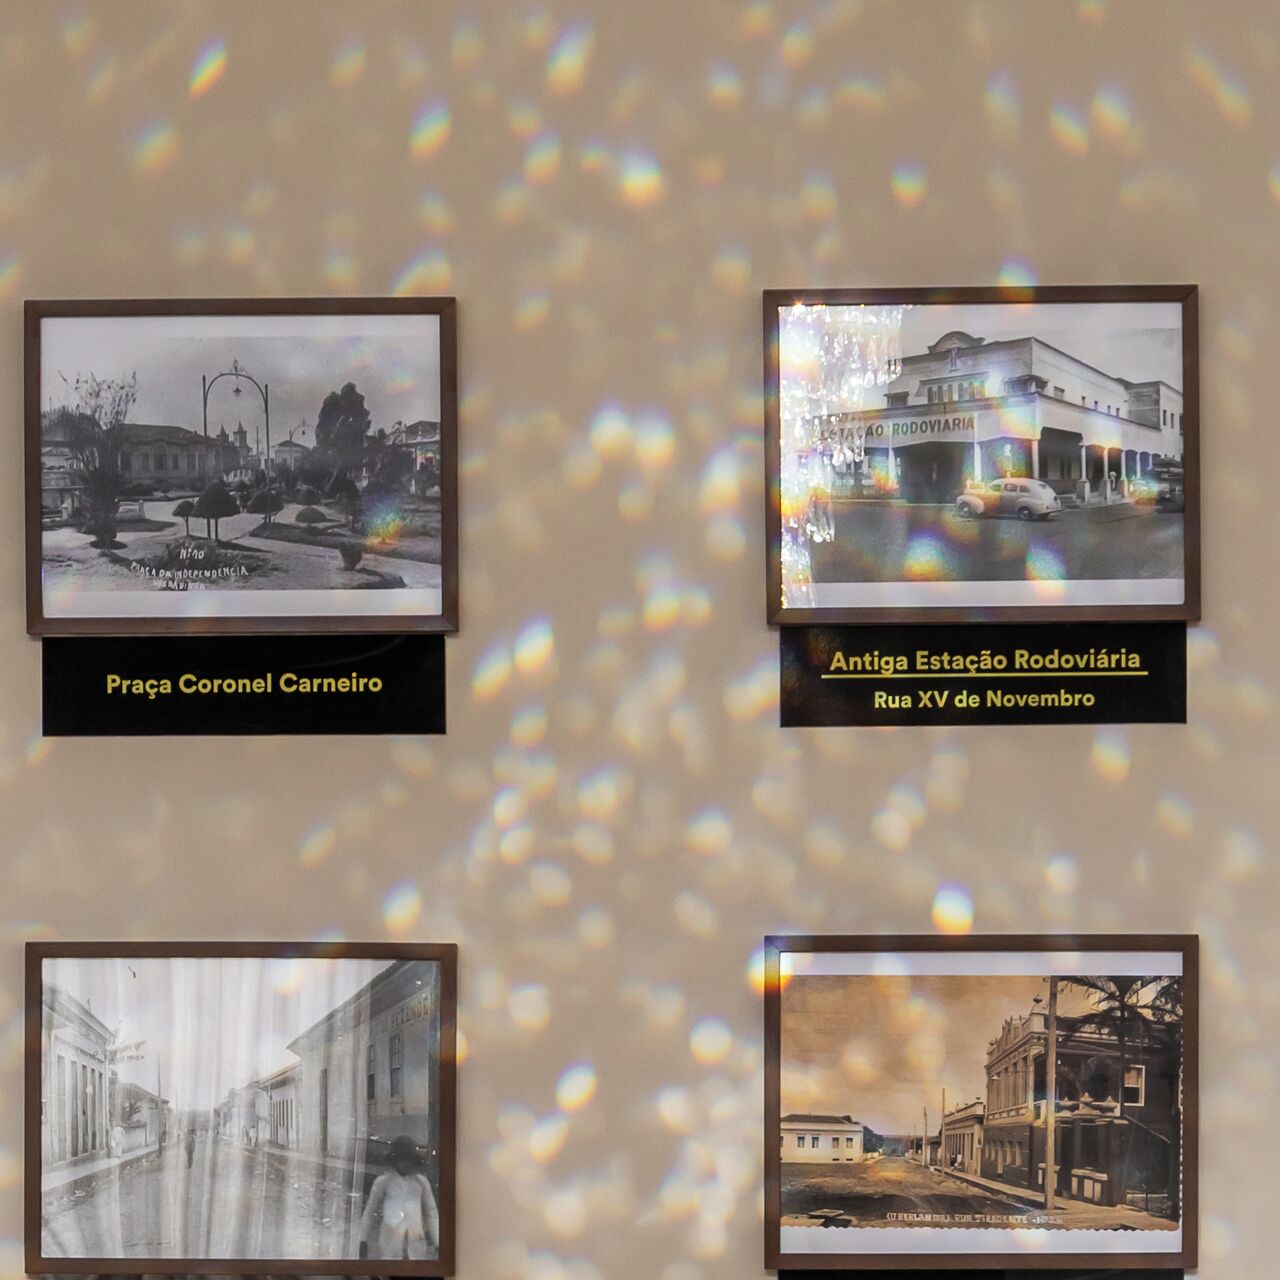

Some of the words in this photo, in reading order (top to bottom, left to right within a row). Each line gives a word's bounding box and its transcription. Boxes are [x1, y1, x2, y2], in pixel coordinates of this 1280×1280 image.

[830, 650, 908, 674] Antiga
[916, 650, 1008, 674] Estação
[1014, 648, 1140, 670] Rodoviária
[106, 674, 172, 700] Praça
[178, 672, 272, 694] Coronel
[279, 672, 383, 693] Carneiro
[874, 691, 912, 709] Rua
[918, 690, 949, 708] XV
[954, 690, 981, 708] de
[987, 689, 1096, 708] Novembro
